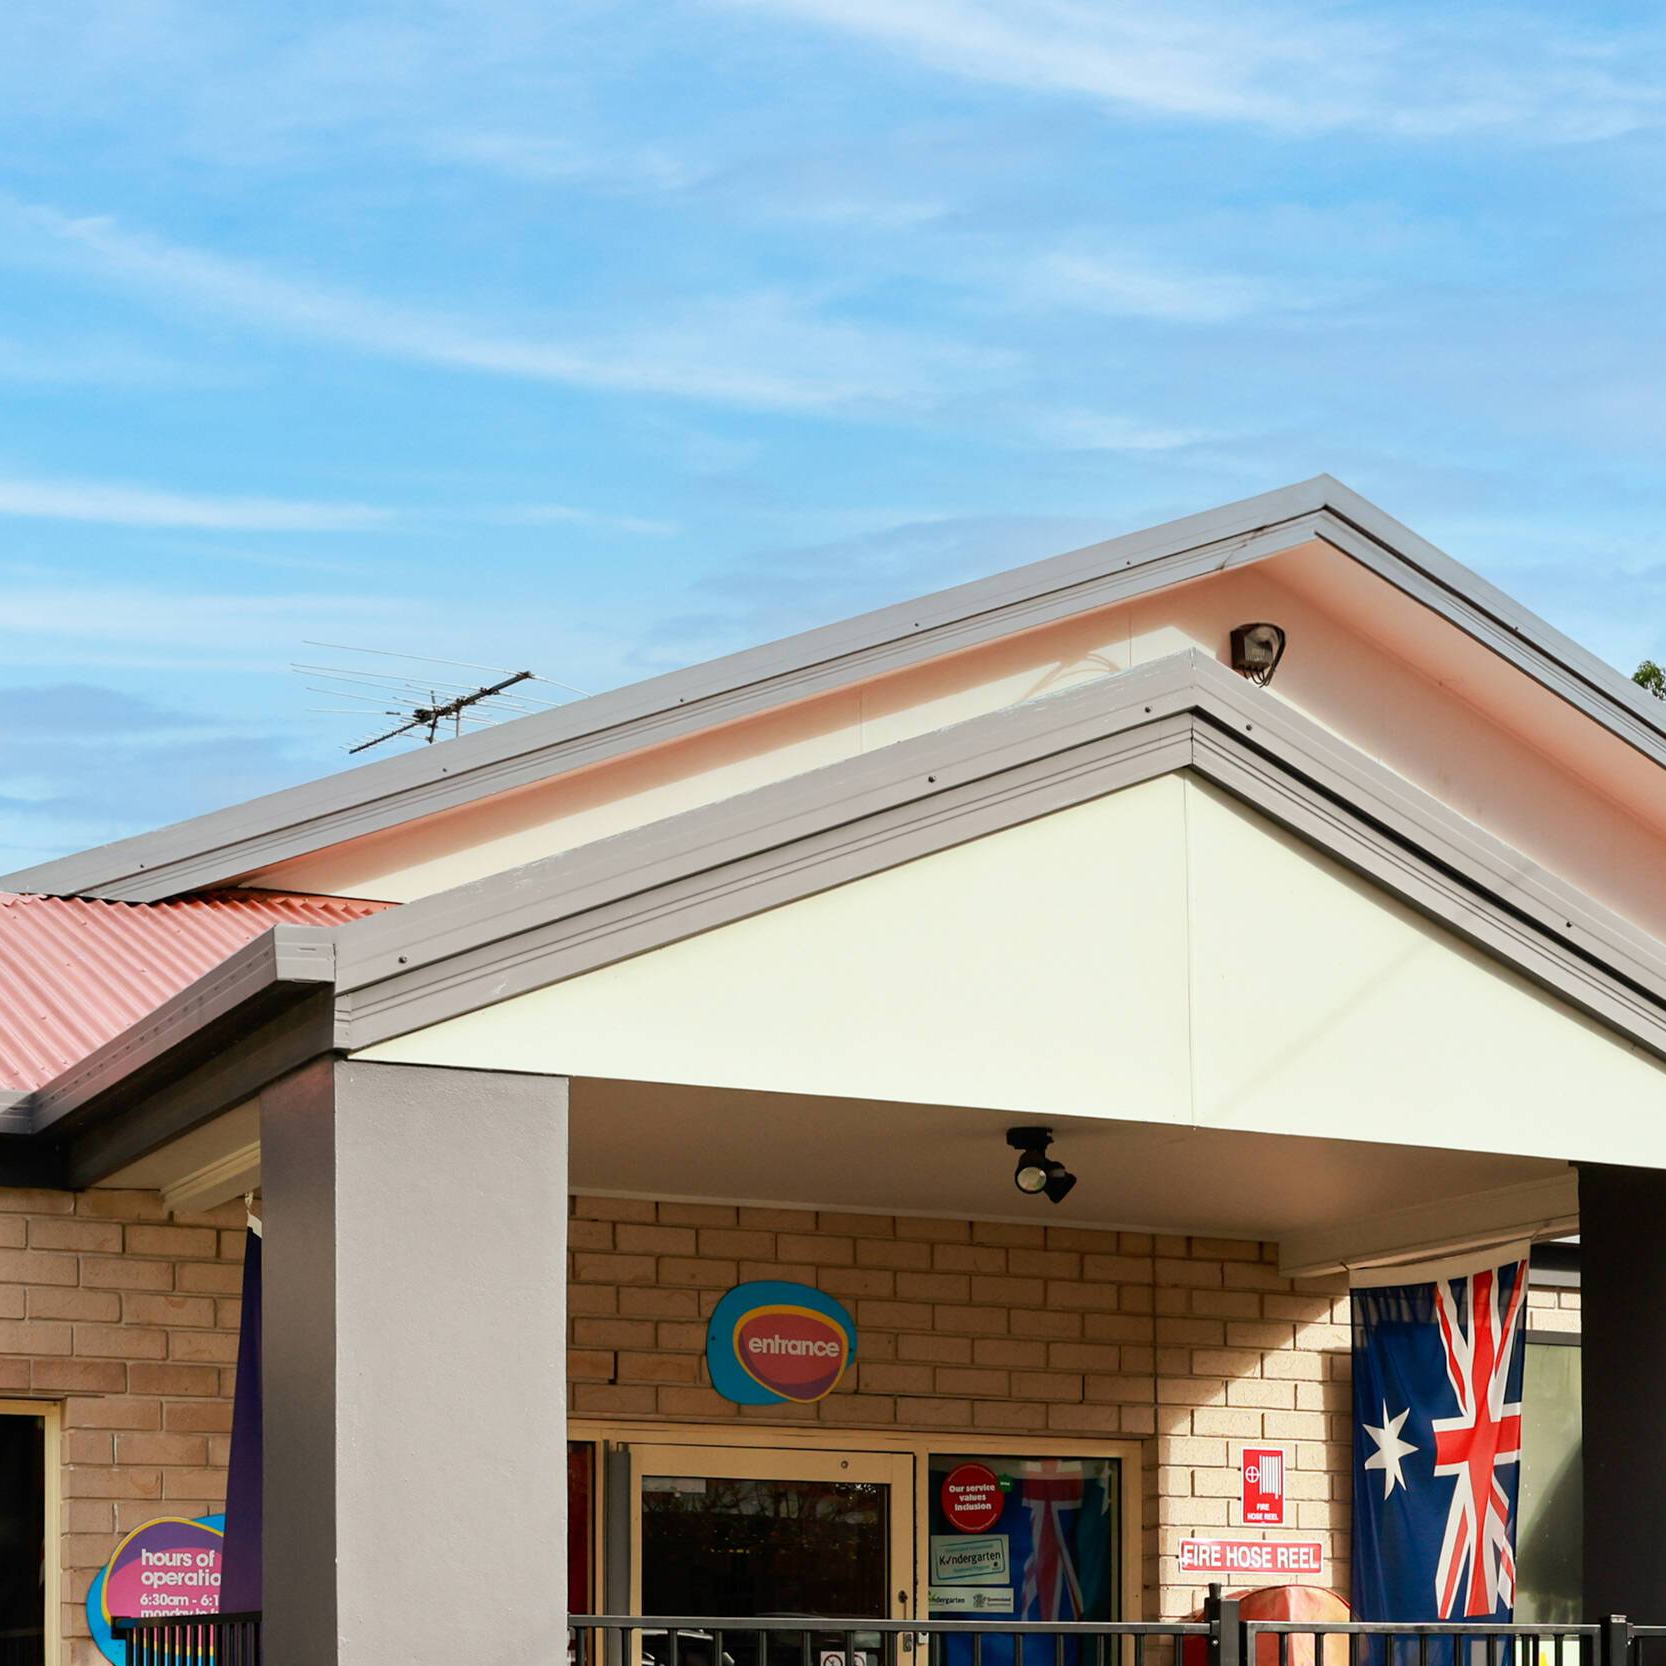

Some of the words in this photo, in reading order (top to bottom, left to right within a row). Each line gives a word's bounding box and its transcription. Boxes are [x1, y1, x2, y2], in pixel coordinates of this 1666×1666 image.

[748, 1334, 840, 1358] entrance
[949, 1485, 964, 1493] Our
[966, 1484, 996, 1492] service
[959, 1494, 986, 1502] values
[1256, 1503, 1270, 1511] FIRE
[141, 1549, 192, 1566] hours
[196, 1550, 216, 1566] of
[1182, 1545, 1221, 1567] FIRE
[1226, 1546, 1272, 1568] HOSE
[1276, 1548, 1320, 1568] REEL
[141, 1569, 221, 1588] operatio
[140, 1594, 189, 1606] 6:30am
